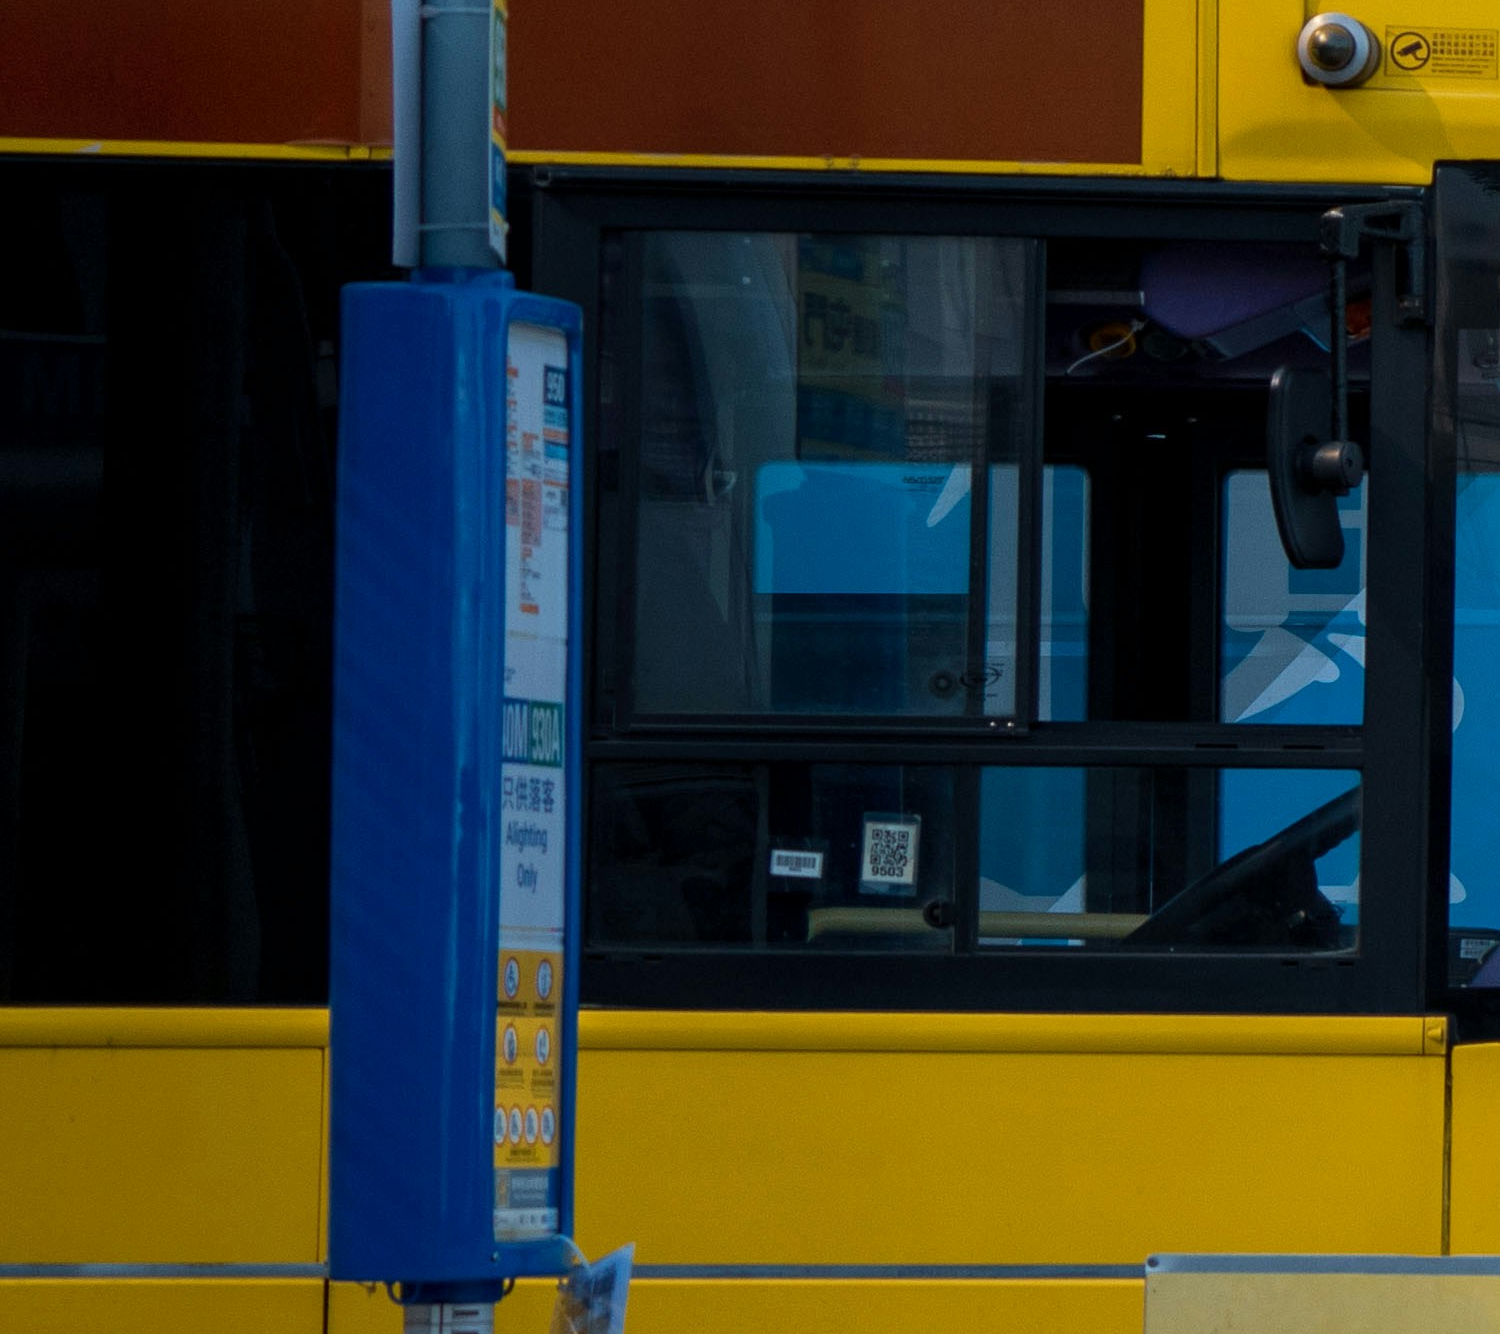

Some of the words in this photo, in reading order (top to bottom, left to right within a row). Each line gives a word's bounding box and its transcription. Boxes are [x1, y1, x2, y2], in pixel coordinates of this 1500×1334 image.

[532, 705, 561, 763] 930A
[503, 775, 554, 813] 只供落客
[506, 820, 547, 854] Alighting
[517, 862, 538, 894] Only
[871, 866, 904, 878] 9503
